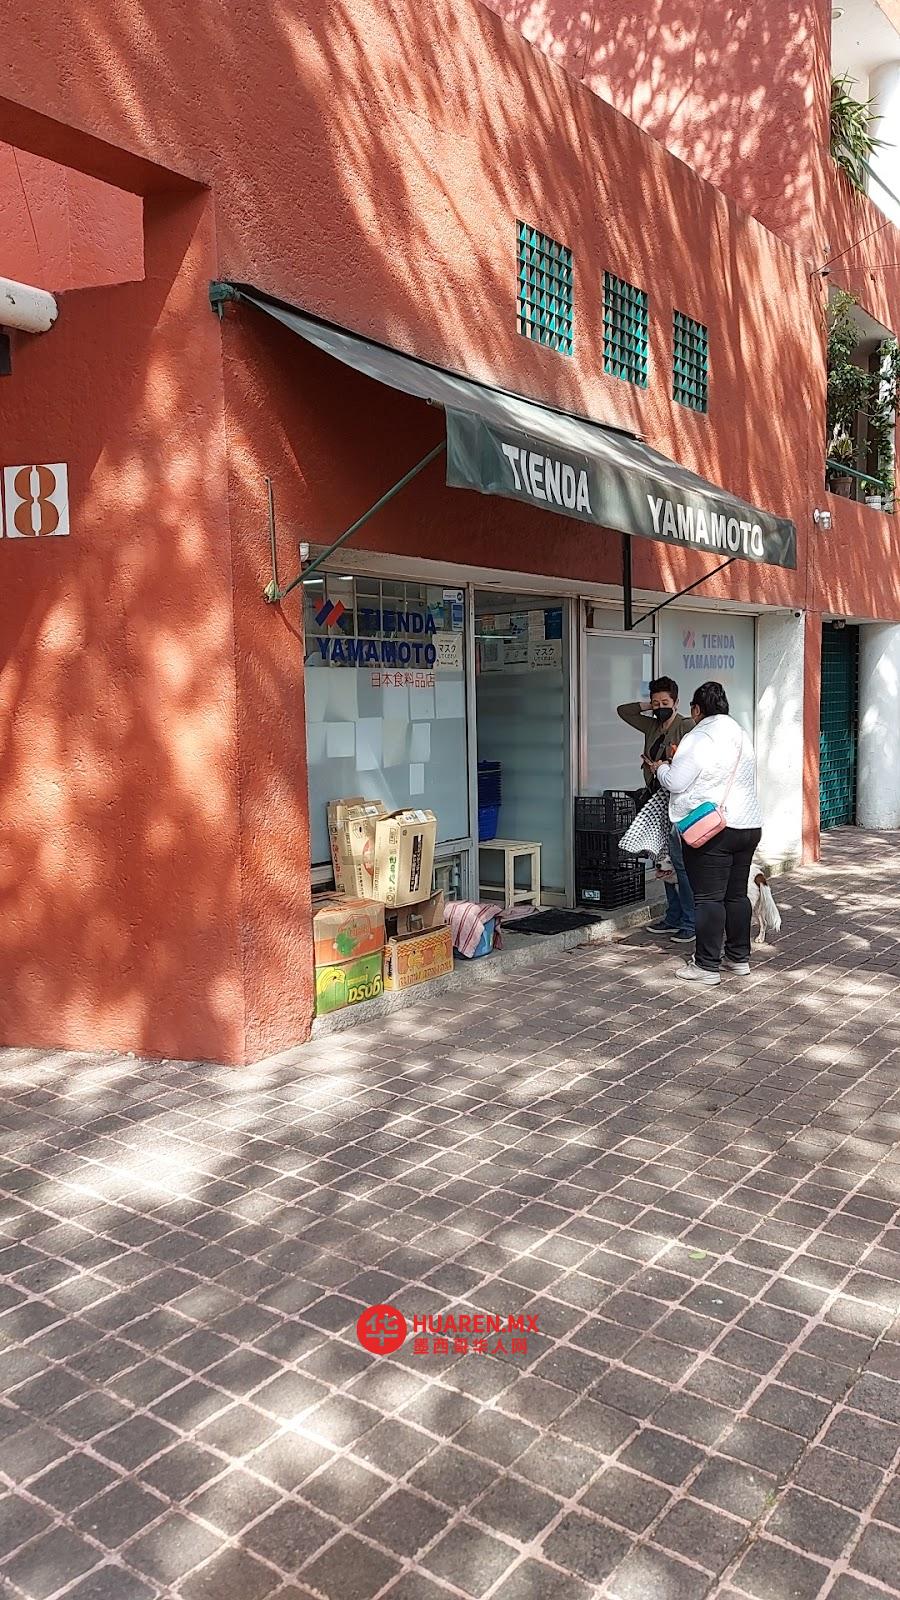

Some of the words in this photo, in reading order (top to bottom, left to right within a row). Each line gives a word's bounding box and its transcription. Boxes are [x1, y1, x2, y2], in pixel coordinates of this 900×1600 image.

[14, 465, 60, 536] 8
[502, 443, 592, 514] TIENDA
[647, 495, 765, 557] YAMAMOTO
[360, 608, 437, 634] TIENDA
[315, 637, 437, 665] YAMAMOTO
[702, 634, 735, 649] TIENDA
[683, 654, 735, 669] YAMAMOTO
[371, 671, 436, 688] 日本食料品店
